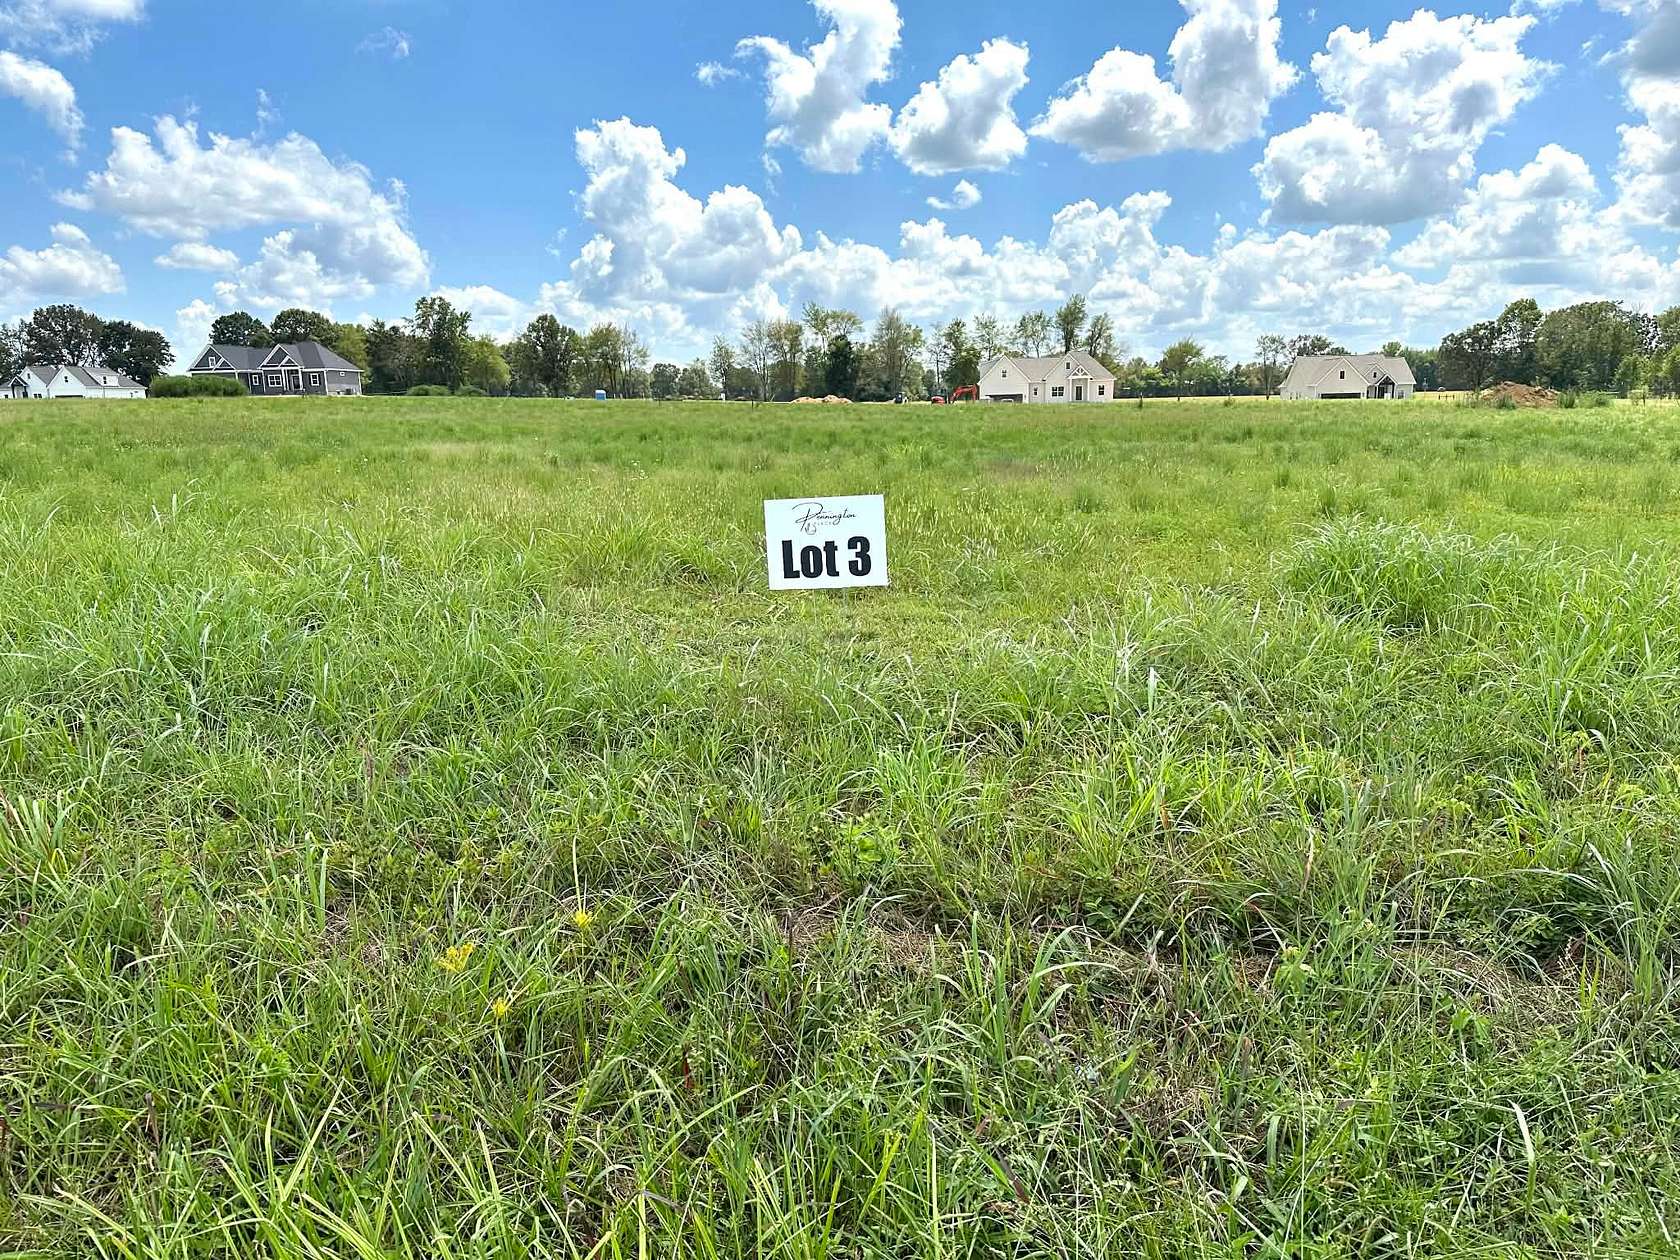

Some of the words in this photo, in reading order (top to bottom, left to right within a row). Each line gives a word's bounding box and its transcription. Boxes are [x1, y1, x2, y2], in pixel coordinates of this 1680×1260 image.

[792, 502, 856, 532] Pennington
[782, 540, 839, 578] Lot
[847, 536, 872, 576] 3
